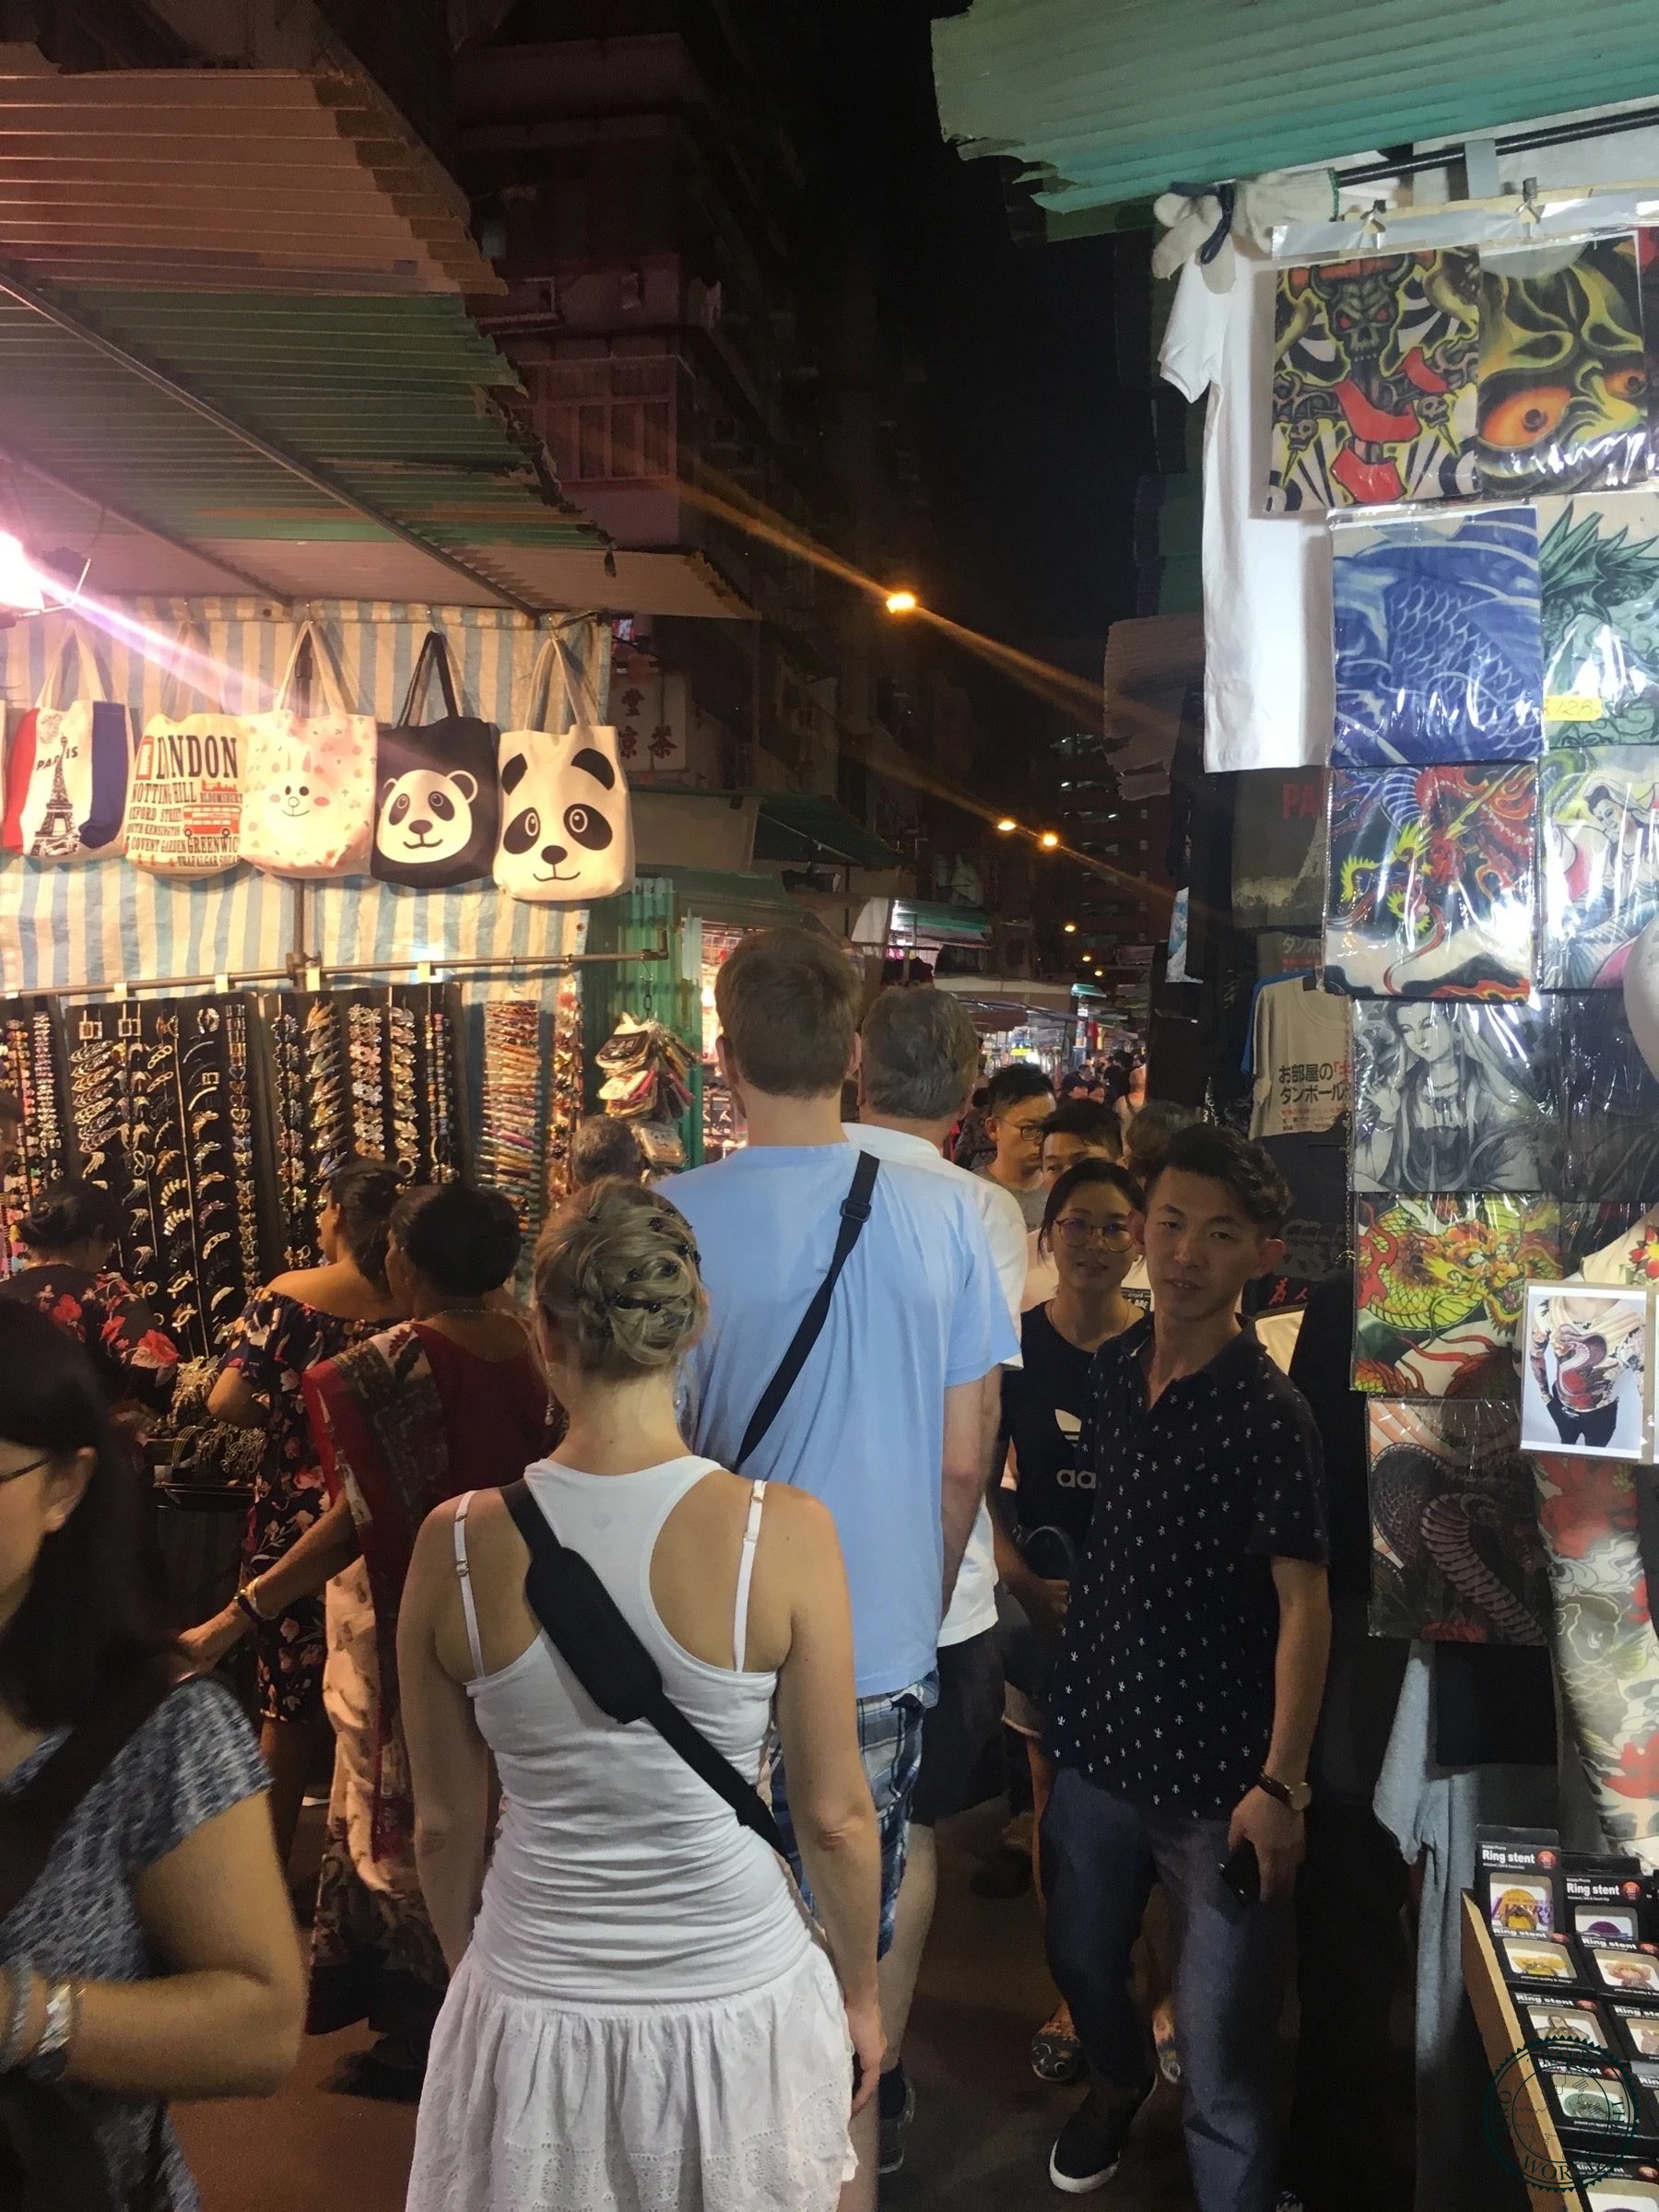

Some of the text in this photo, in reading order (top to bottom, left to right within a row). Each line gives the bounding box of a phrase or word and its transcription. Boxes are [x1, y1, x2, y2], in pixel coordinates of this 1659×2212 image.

[172, 782, 196, 803] HILL
[1482, 1849, 1535, 1864] Ring stent
[1567, 1883, 1620, 1896] Ring stent
[1493, 1927, 1517, 1936] Ring
[1582, 1937, 1606, 1947] Ring
[1608, 1941, 1638, 1949] stent
[1516, 1994, 1542, 2003] Ring
[1544, 1997, 1574, 2006] stent
[1614, 2006, 1641, 2016] Ring
